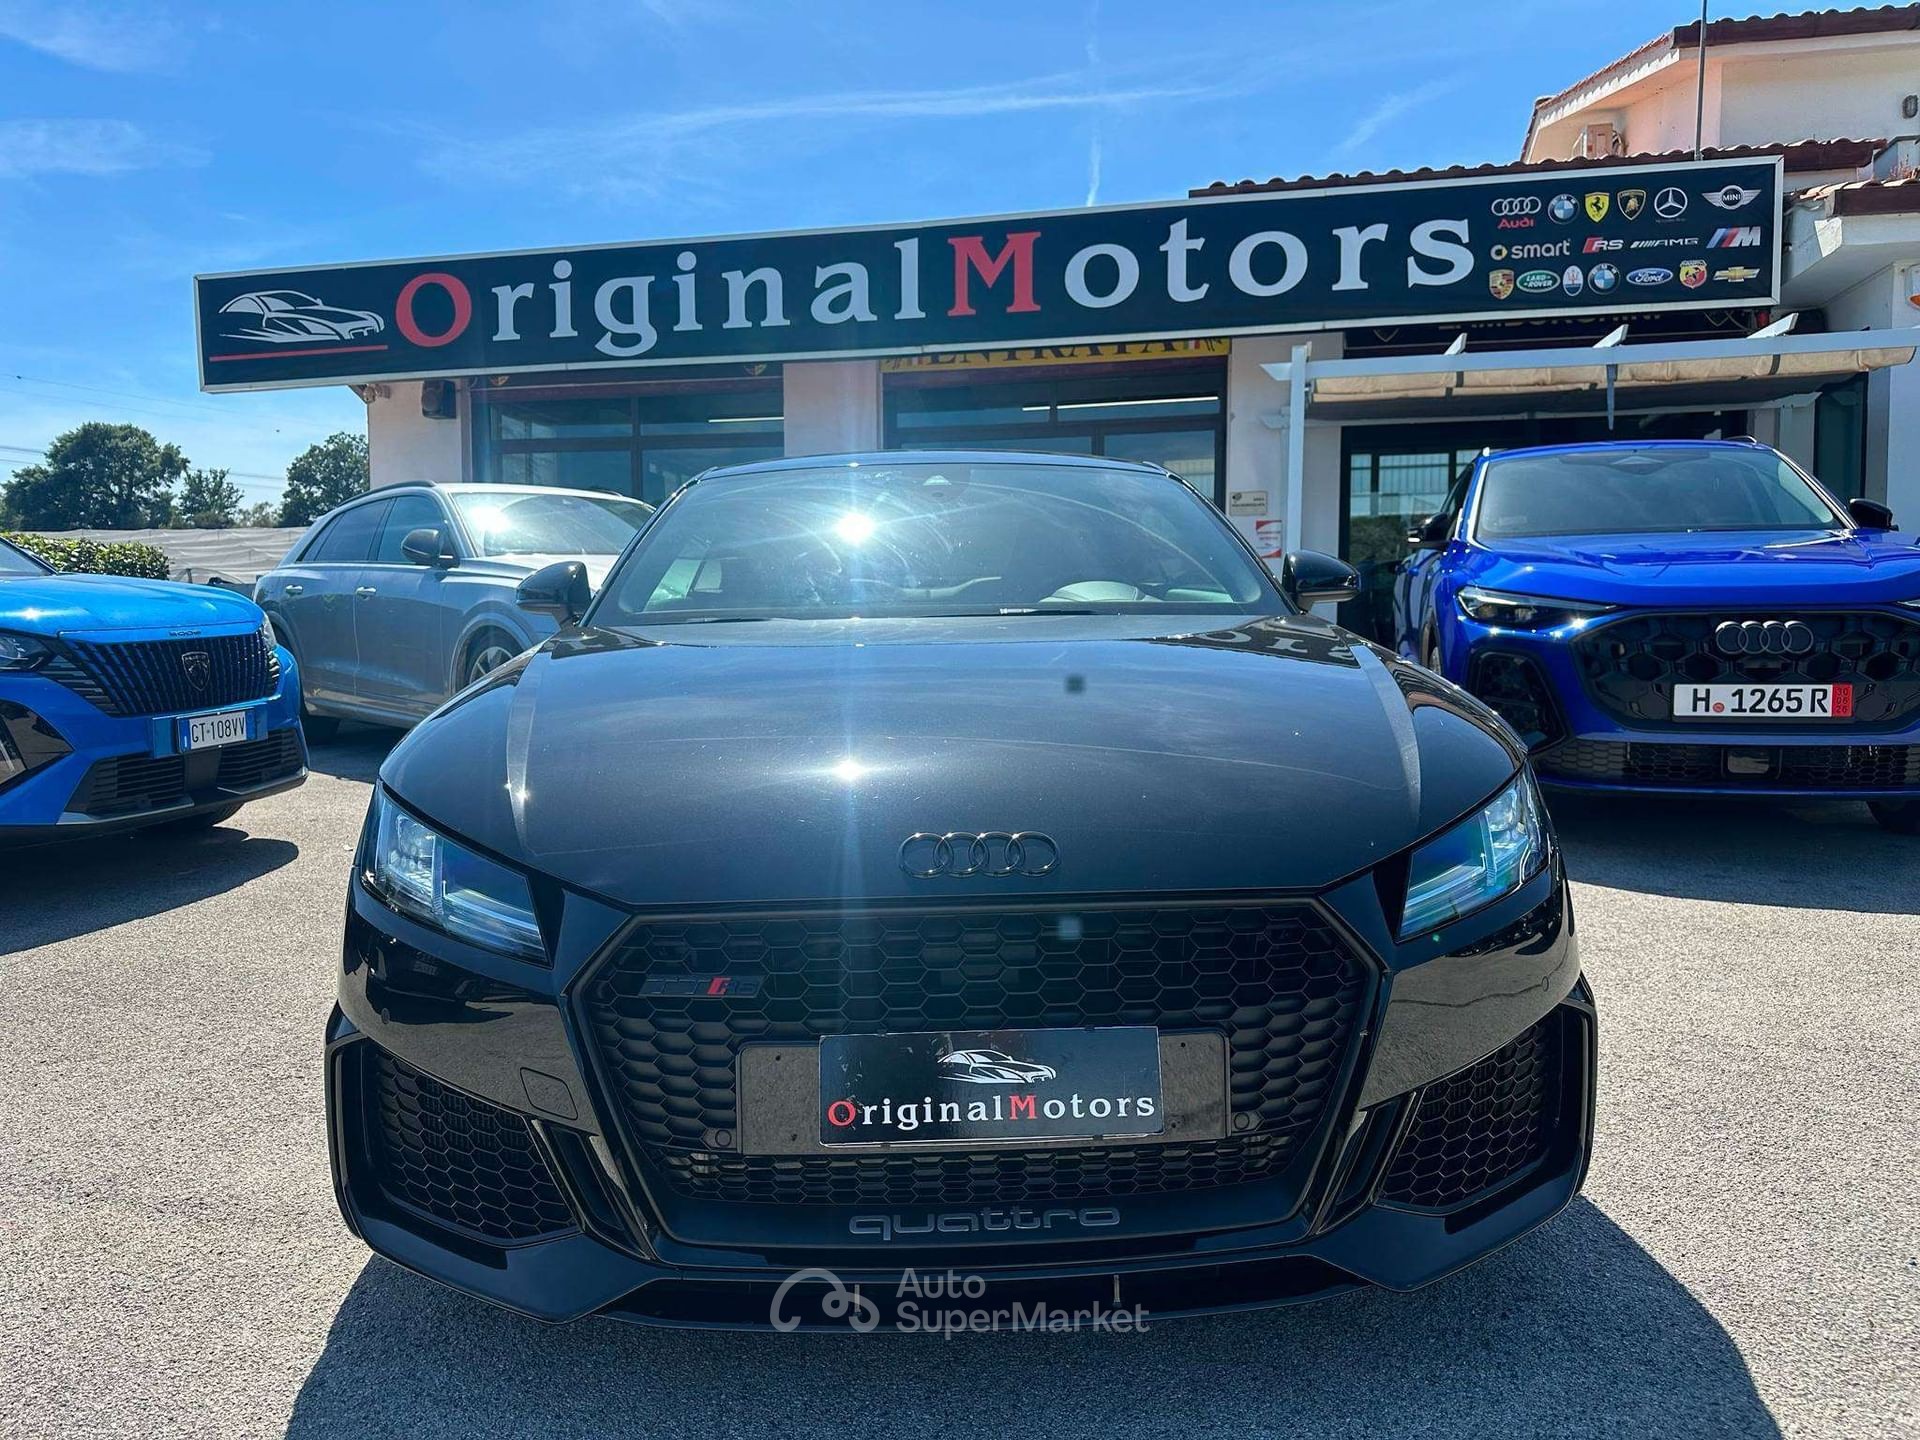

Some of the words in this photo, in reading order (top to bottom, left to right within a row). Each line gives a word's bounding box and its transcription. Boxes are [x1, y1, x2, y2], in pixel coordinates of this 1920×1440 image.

[1722, 192, 1741, 201] MINI
[1497, 217, 1535, 230] Audi
[1511, 240, 1571, 260] smart
[1585, 236, 1625, 253] RS
[1634, 272, 1664, 282] Ford
[1527, 280, 1553, 288] ROVER
[848, 1206, 1121, 1241] quattro
